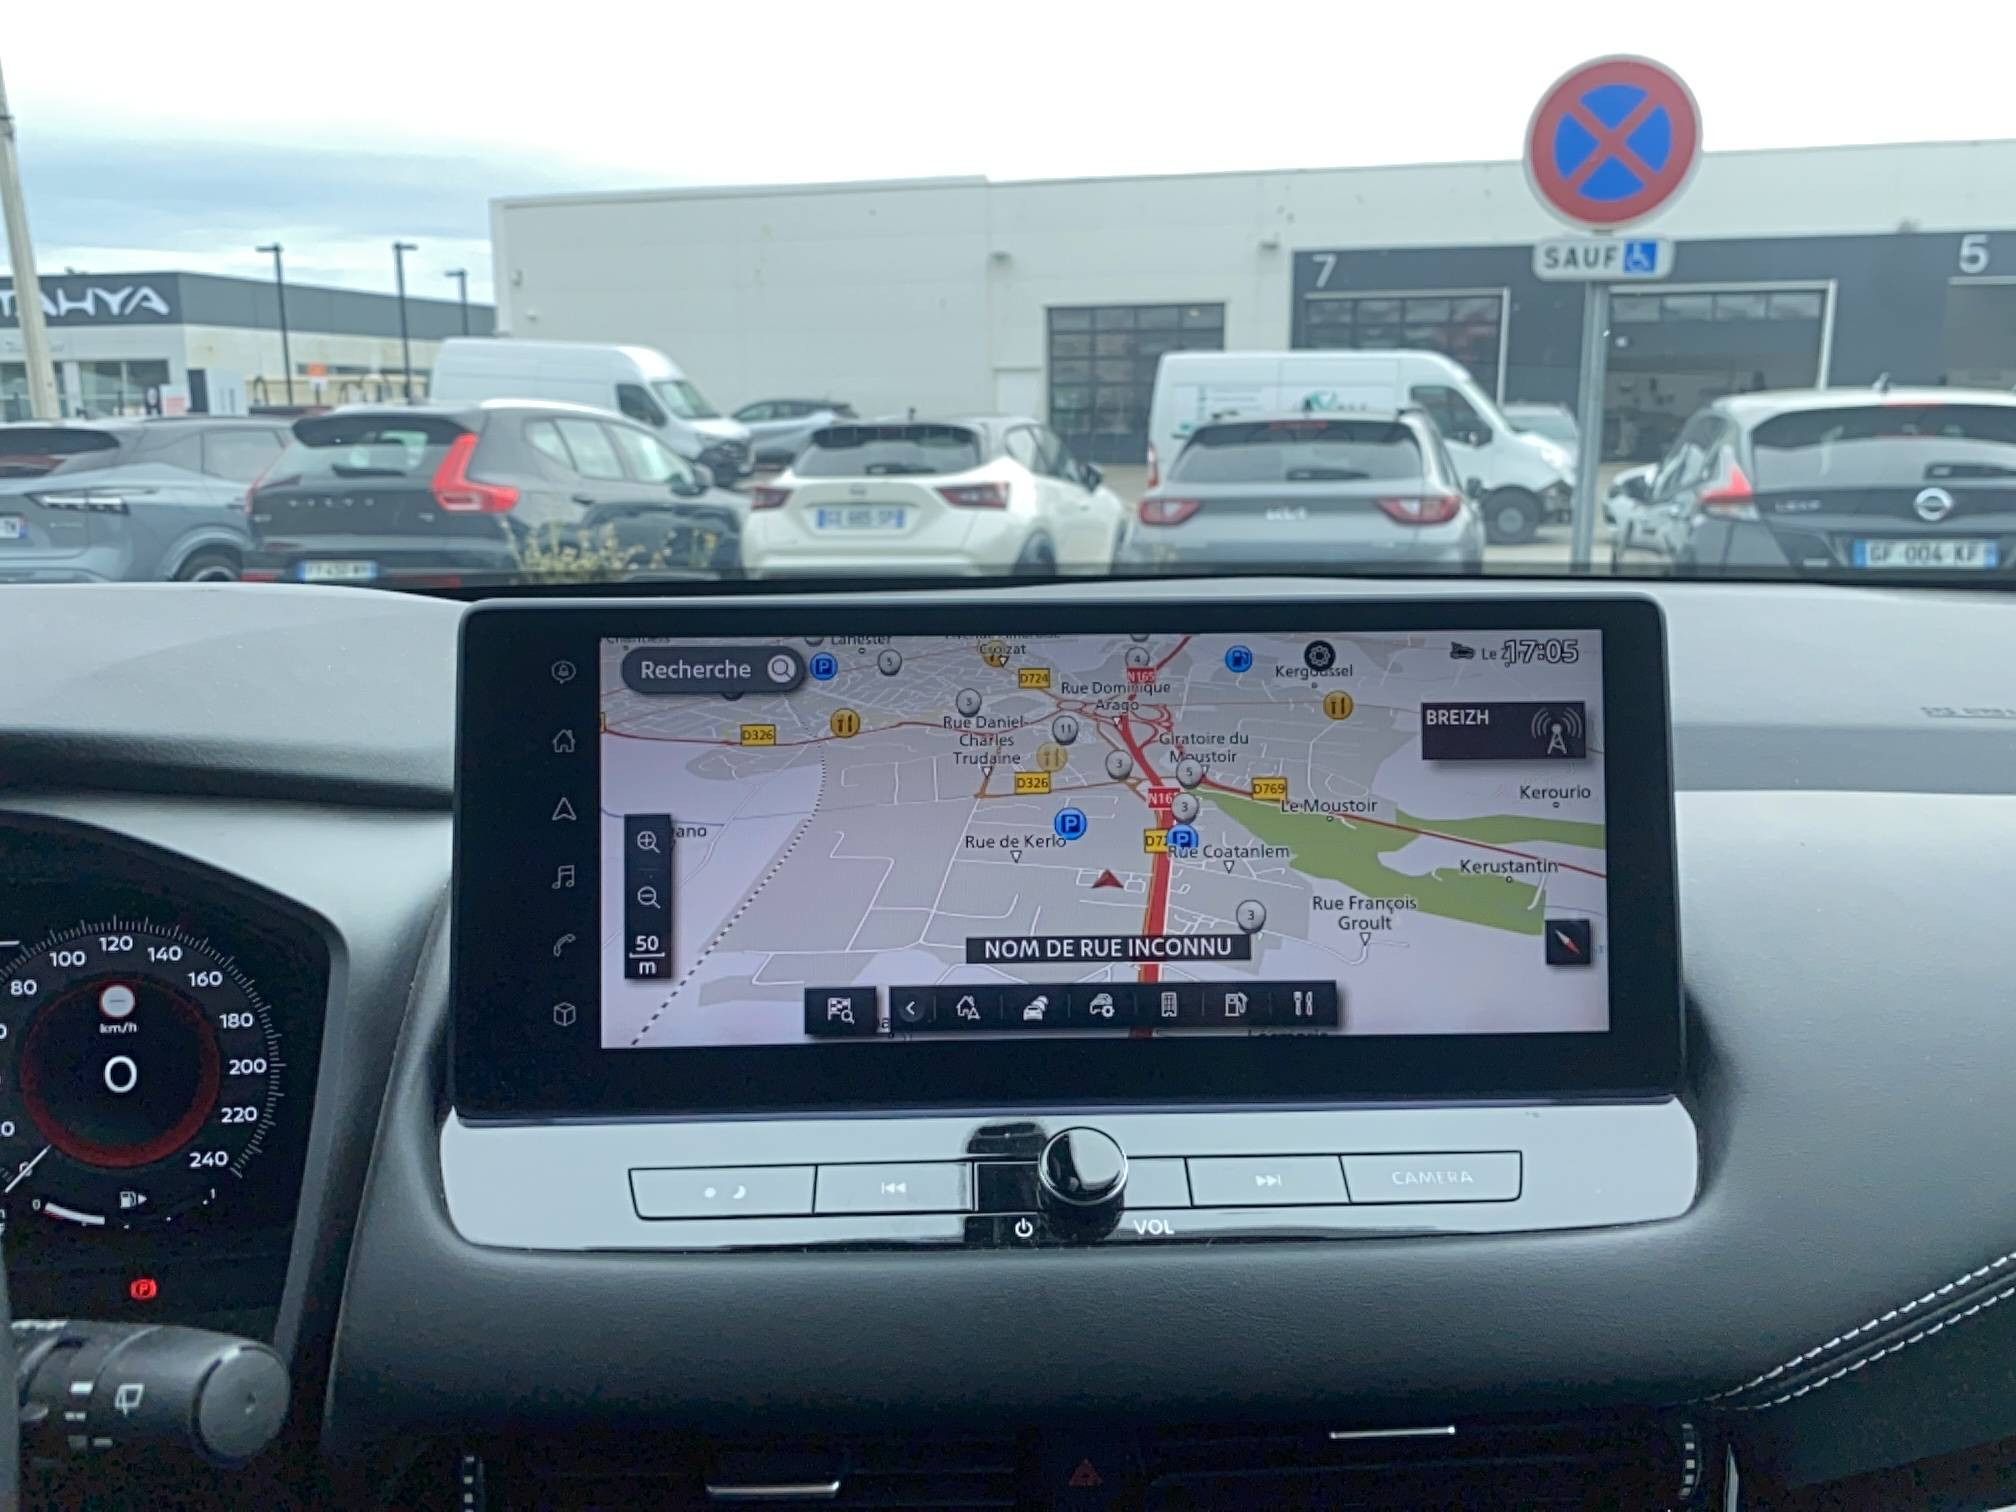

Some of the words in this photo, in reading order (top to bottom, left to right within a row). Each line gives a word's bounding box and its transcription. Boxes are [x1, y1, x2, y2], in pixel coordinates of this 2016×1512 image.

[1543, 245, 1618, 270] SAUF
[1960, 233, 1988, 274] 5
[1312, 253, 1338, 288] 7
[1504, 638, 1579, 664] 17:05
[1133, 654, 1142, 664] 4
[640, 658, 752, 680] Recherche
[1127, 670, 1156, 683] N165
[1019, 672, 1049, 684] D724
[1061, 682, 1089, 694] Rue
[1092, 681, 1171, 697] Dominique
[1095, 700, 1140, 713] Arago
[943, 716, 972, 729] Rue
[1425, 708, 1490, 725] BREIZH
[742, 729, 774, 741] D326
[1060, 723, 1072, 734] 11
[959, 733, 1015, 747] Charles
[1159, 732, 1225, 745] Giratoire
[1229, 732, 1249, 745] du
[953, 751, 1021, 765] Trudaine
[1115, 758, 1123, 768] 3
[1170, 750, 1237, 763] Moustoir
[1185, 766, 1194, 778] 5
[1016, 777, 1049, 789] D326
[1253, 783, 1286, 795] D769
[1520, 784, 1592, 799] Kerourio
[1181, 801, 1189, 813] 3
[1281, 800, 1299, 813] Le
[1304, 799, 1378, 813] Moustoir
[965, 835, 996, 849] Rue
[1000, 835, 1015, 848] de
[1024, 834, 1067, 848] Kerlo
[1168, 845, 1198, 859] Rue
[1202, 844, 1290, 859] Coatanlem
[1459, 858, 1559, 874] Kerustantin
[1313, 896, 1344, 911] Rue
[1348, 895, 1417, 913] François
[1247, 908, 1255, 921] 3
[1338, 915, 1393, 930] Groult
[99, 936, 133, 951] 120
[635, 934, 660, 951] 50
[984, 940, 1040, 959] NOM
[1046, 940, 1075, 958] DE
[1080, 939, 1123, 958] RUE
[1128, 937, 1232, 957] INCONNU
[49, 951, 86, 967] 100
[148, 945, 183, 963] 140
[639, 961, 656, 975] m
[187, 970, 224, 988] 160
[10, 979, 38, 996] 80
[99, 1022, 138, 1034] km/h
[219, 1012, 254, 1029] 180
[104, 1055, 138, 1093] 0
[229, 1058, 268, 1075] 200
[221, 1106, 258, 1123] 220
[189, 1151, 229, 1168] 240
[1391, 1169, 1475, 1187] CAMERA
[1133, 1219, 1175, 1236] VOL
